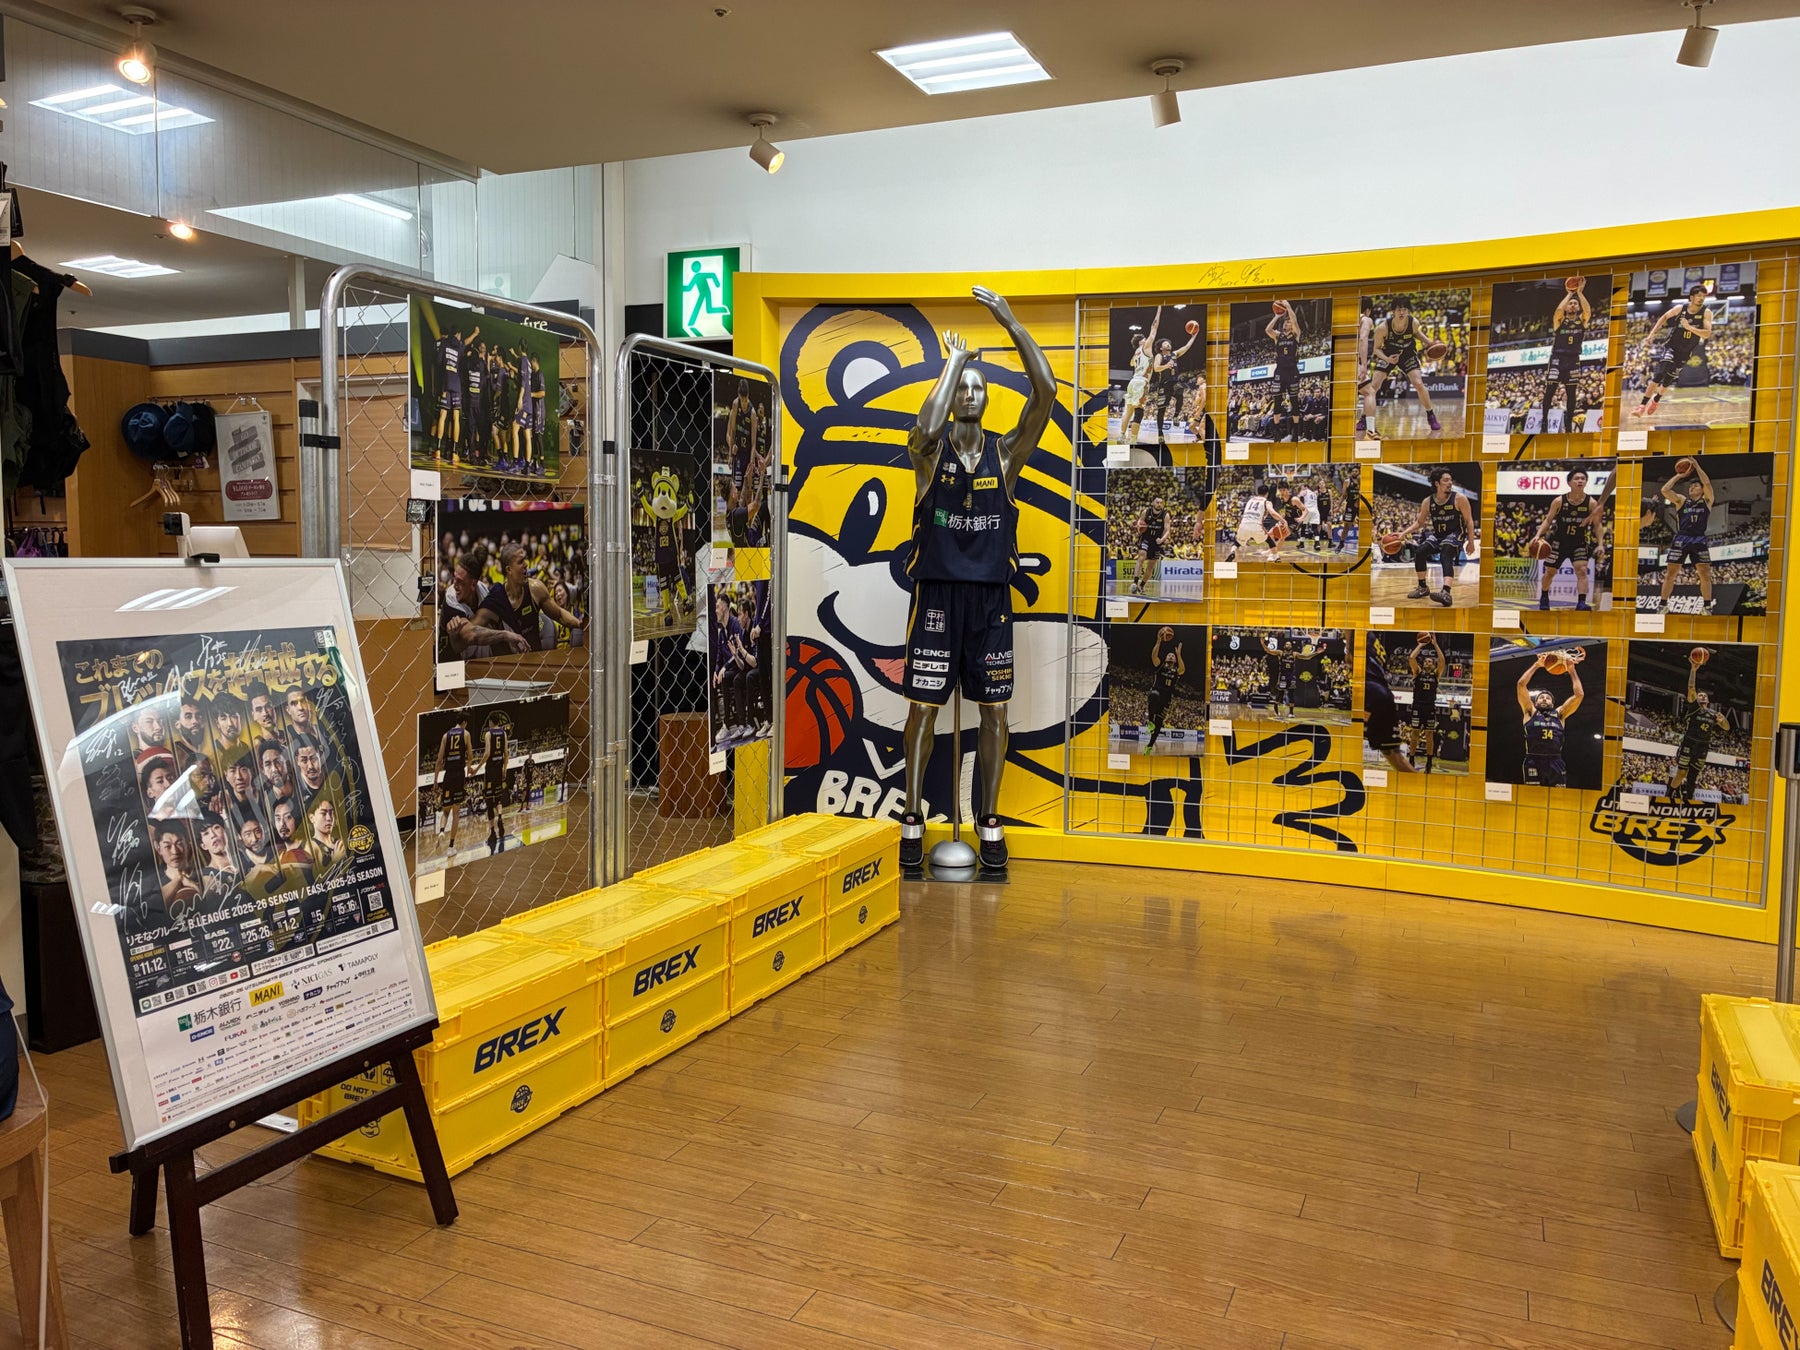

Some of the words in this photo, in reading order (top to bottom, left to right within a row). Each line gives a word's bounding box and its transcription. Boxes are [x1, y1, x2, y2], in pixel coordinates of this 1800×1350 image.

[520, 316, 548, 331] fire
[1567, 335, 1574, 345] 9
[1683, 330, 1693, 339] 10
[1532, 476, 1560, 491] FKD
[1247, 501, 1260, 511] 14
[947, 514, 1001, 531] 栃木銀行
[1690, 514, 1699, 523] 17
[1566, 525, 1578, 537] 15
[1164, 566, 1203, 576] Hirata
[913, 648, 951, 658] O-ENCE
[985, 650, 1013, 662] ALME
[74, 649, 164, 685] これまでの
[915, 662, 947, 671] ニチレキ
[985, 668, 1012, 676] YOSHIN
[915, 679, 944, 687] ナカニシ
[985, 684, 1013, 695] チャップア
[1541, 728, 1554, 740] 34
[1700, 723, 1710, 731] 42
[450, 734, 460, 750] 12
[495, 736, 501, 749] 6
[1600, 798, 1716, 818] UTNOMIYA
[1594, 809, 1734, 841] BREX
[833, 857, 883, 894] BREX
[187, 909, 231, 930] B.LEAGUE
[232, 900, 267, 917] 2025-26
[268, 891, 299, 907] SEASON
[326, 875, 357, 891] 2025-26
[357, 867, 383, 882] SEASON
[752, 895, 804, 938] BREX
[204, 929, 230, 941] EASL
[347, 953, 379, 968] TAMAPOLY
[301, 969, 333, 986] NICIGAS
[633, 944, 702, 997] BREX
[254, 985, 281, 1003] MANI
[193, 997, 242, 1026] 栃木銀行
[473, 1006, 567, 1074] BREX
[353, 1086, 369, 1095] NOT
[1711, 1060, 1732, 1131] BREX
